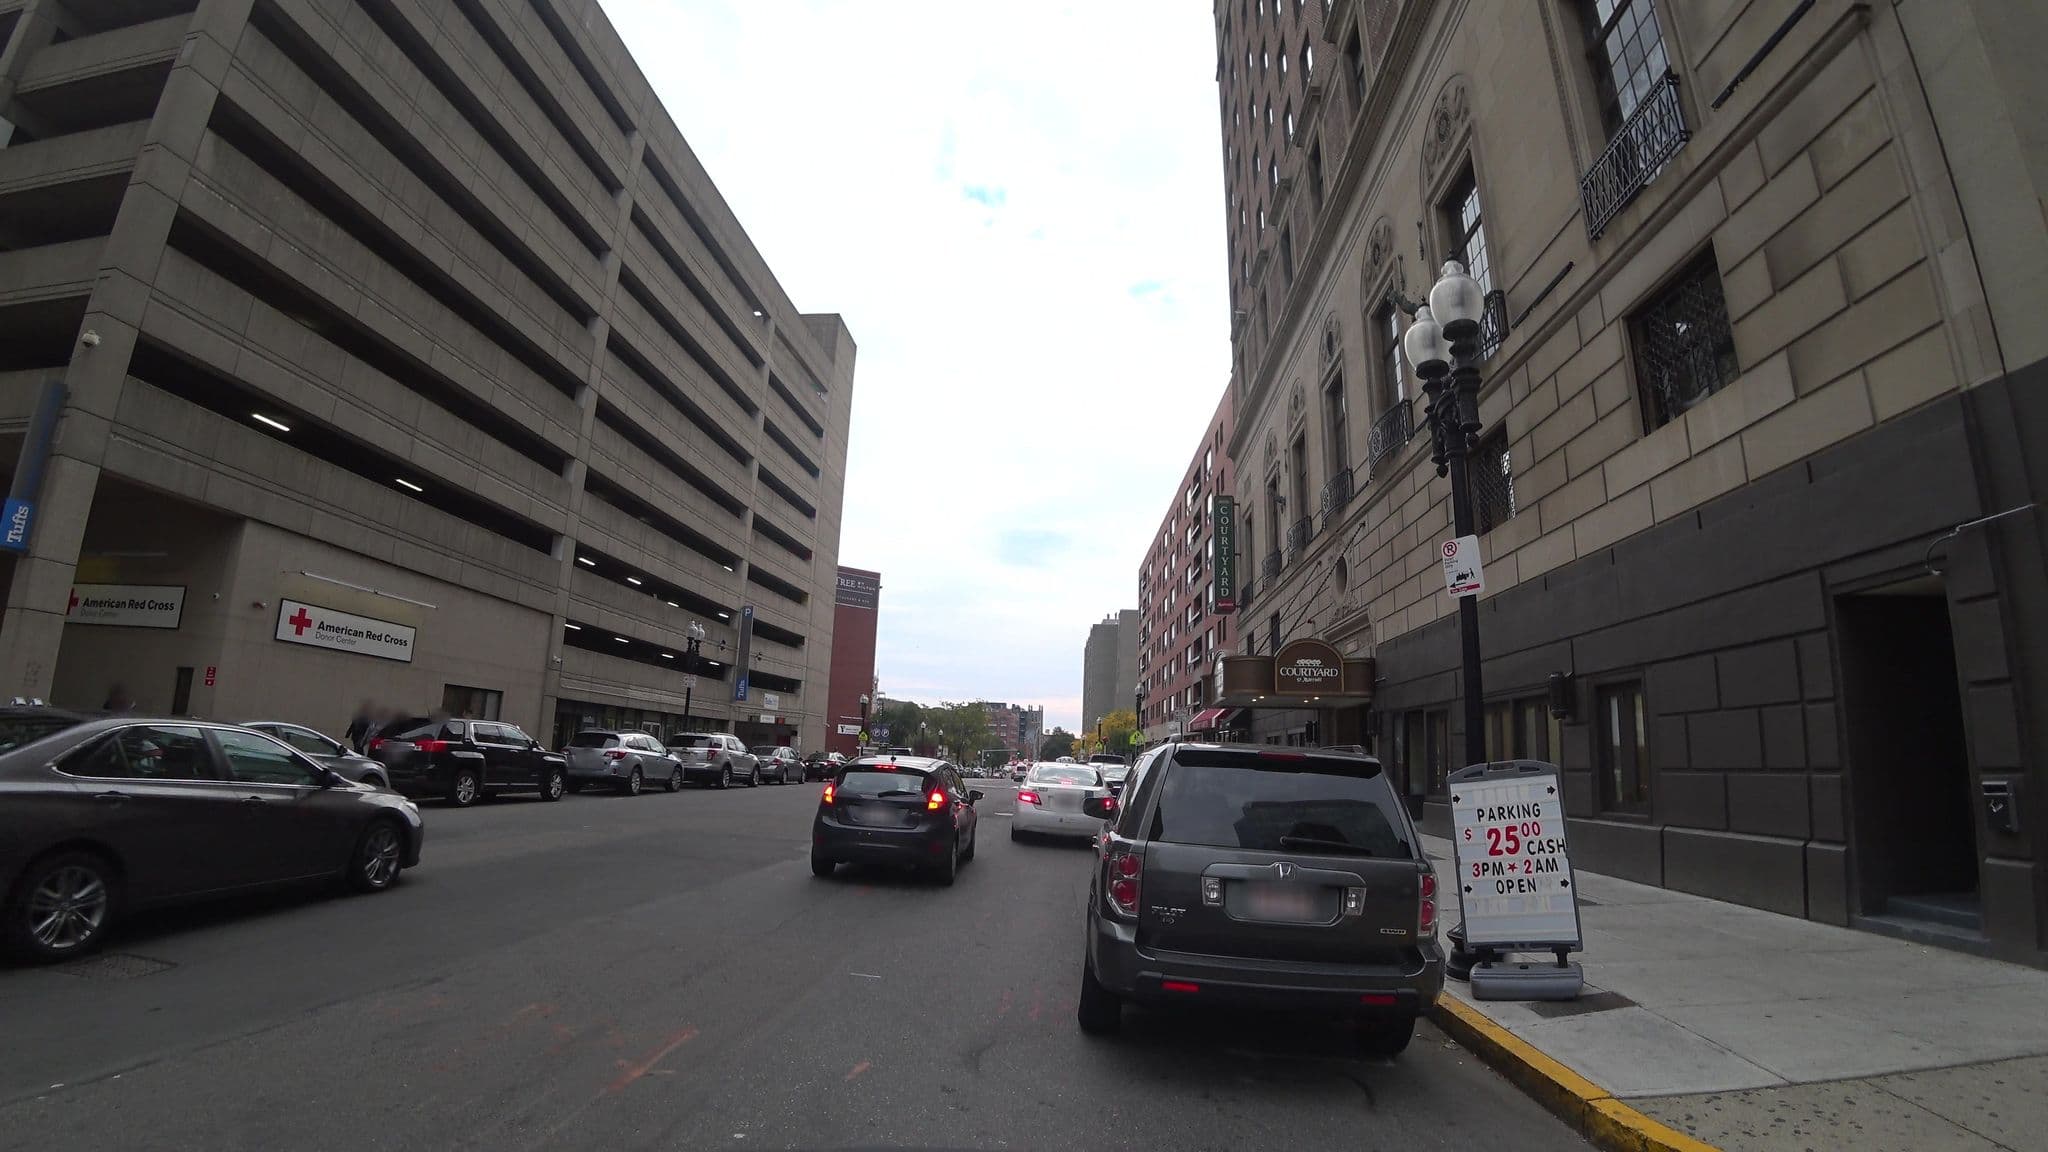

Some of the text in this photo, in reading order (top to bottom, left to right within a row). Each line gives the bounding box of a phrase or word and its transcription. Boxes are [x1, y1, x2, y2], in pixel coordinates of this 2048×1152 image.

[6, 505, 29, 543] Tufts
[1219, 505, 1230, 598] COURTYARD
[82, 598, 175, 611] American Red Cross
[744, 608, 752, 617] P
[315, 631, 357, 646] Donor Center
[317, 620, 408, 647] American Red Cross
[1279, 666, 1339, 677] COURTYARD
[1476, 803, 1541, 822] PARKING
[1464, 828, 1472, 841] $
[1526, 838, 1566, 856] CASH
[1472, 857, 1559, 878] 3PM 2AM
[1496, 877, 1537, 895] OPEN
